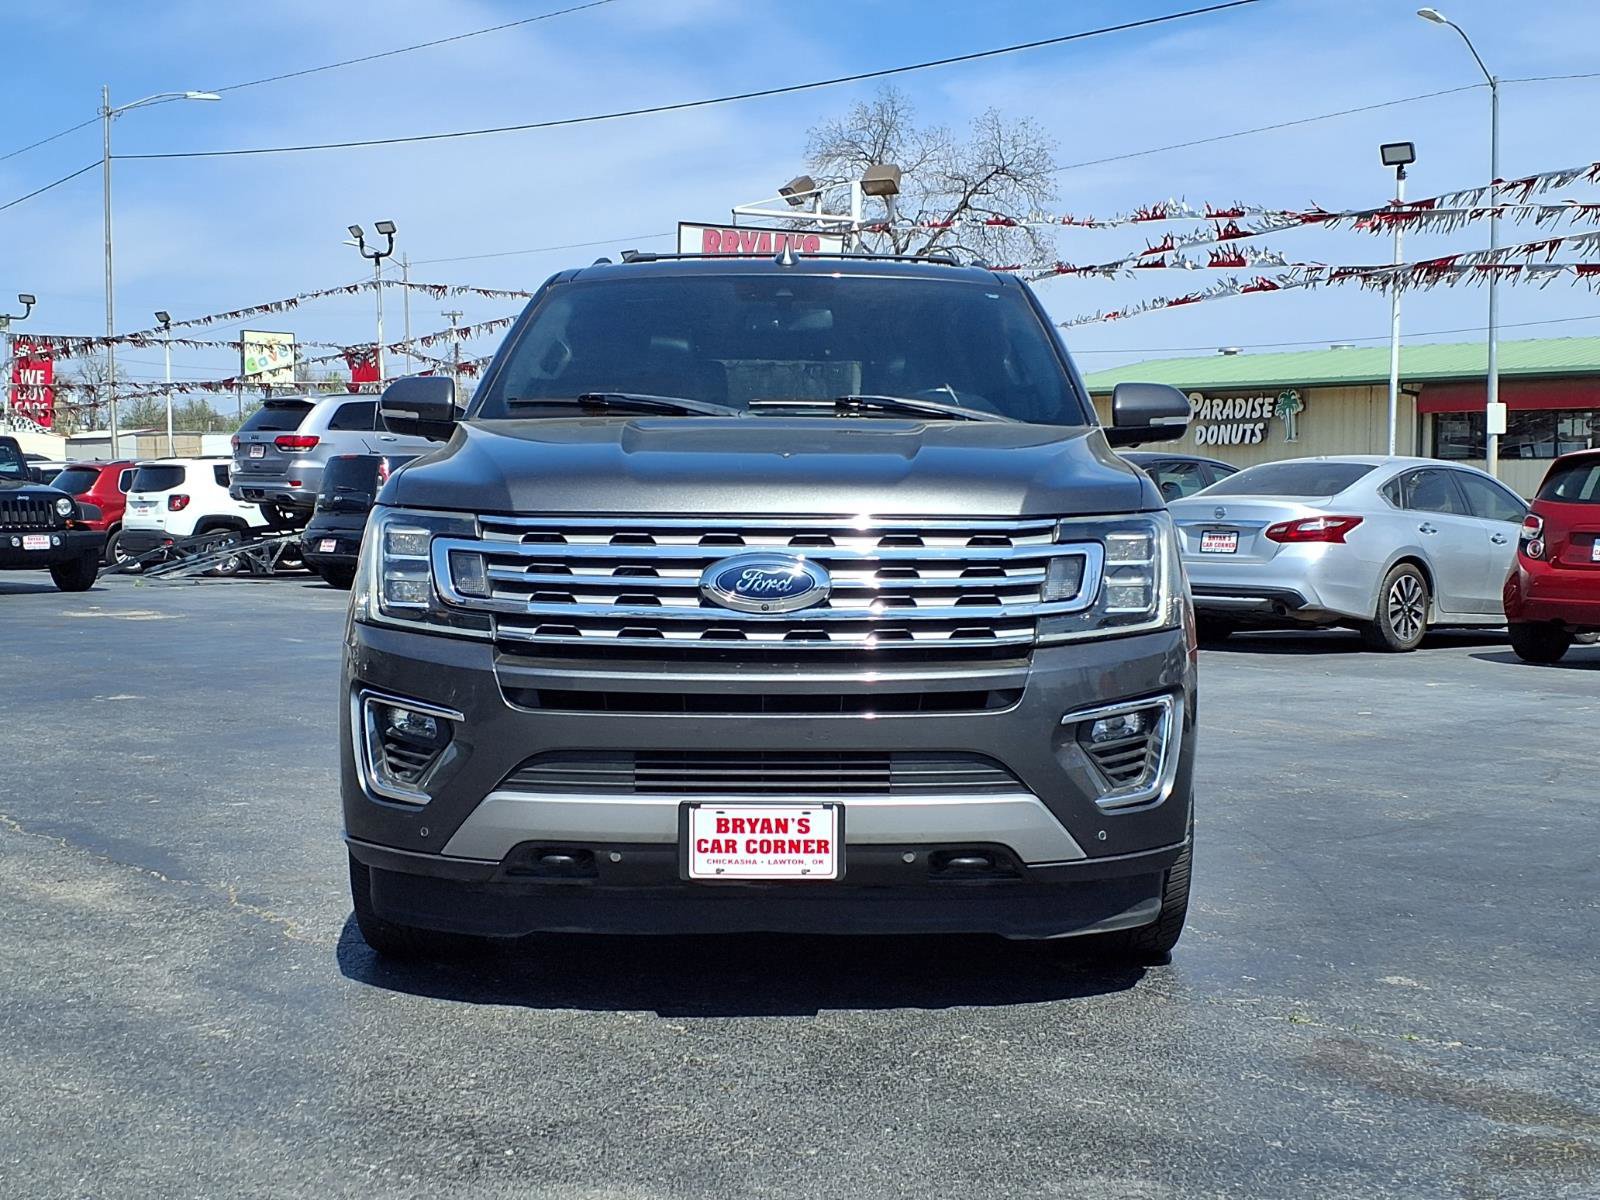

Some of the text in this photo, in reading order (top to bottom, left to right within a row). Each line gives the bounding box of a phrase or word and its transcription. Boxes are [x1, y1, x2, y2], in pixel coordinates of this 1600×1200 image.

[20, 368, 46, 386] WE
[1188, 392, 1275, 421] PARADISE
[1194, 422, 1265, 446] DONUTS
[735, 567, 793, 593] Ford
[716, 817, 811, 834] BRYAN'S
[696, 838, 830, 854] CAR CORNER
[706, 858, 824, 867] CHICKASHA LAWTON, OK
